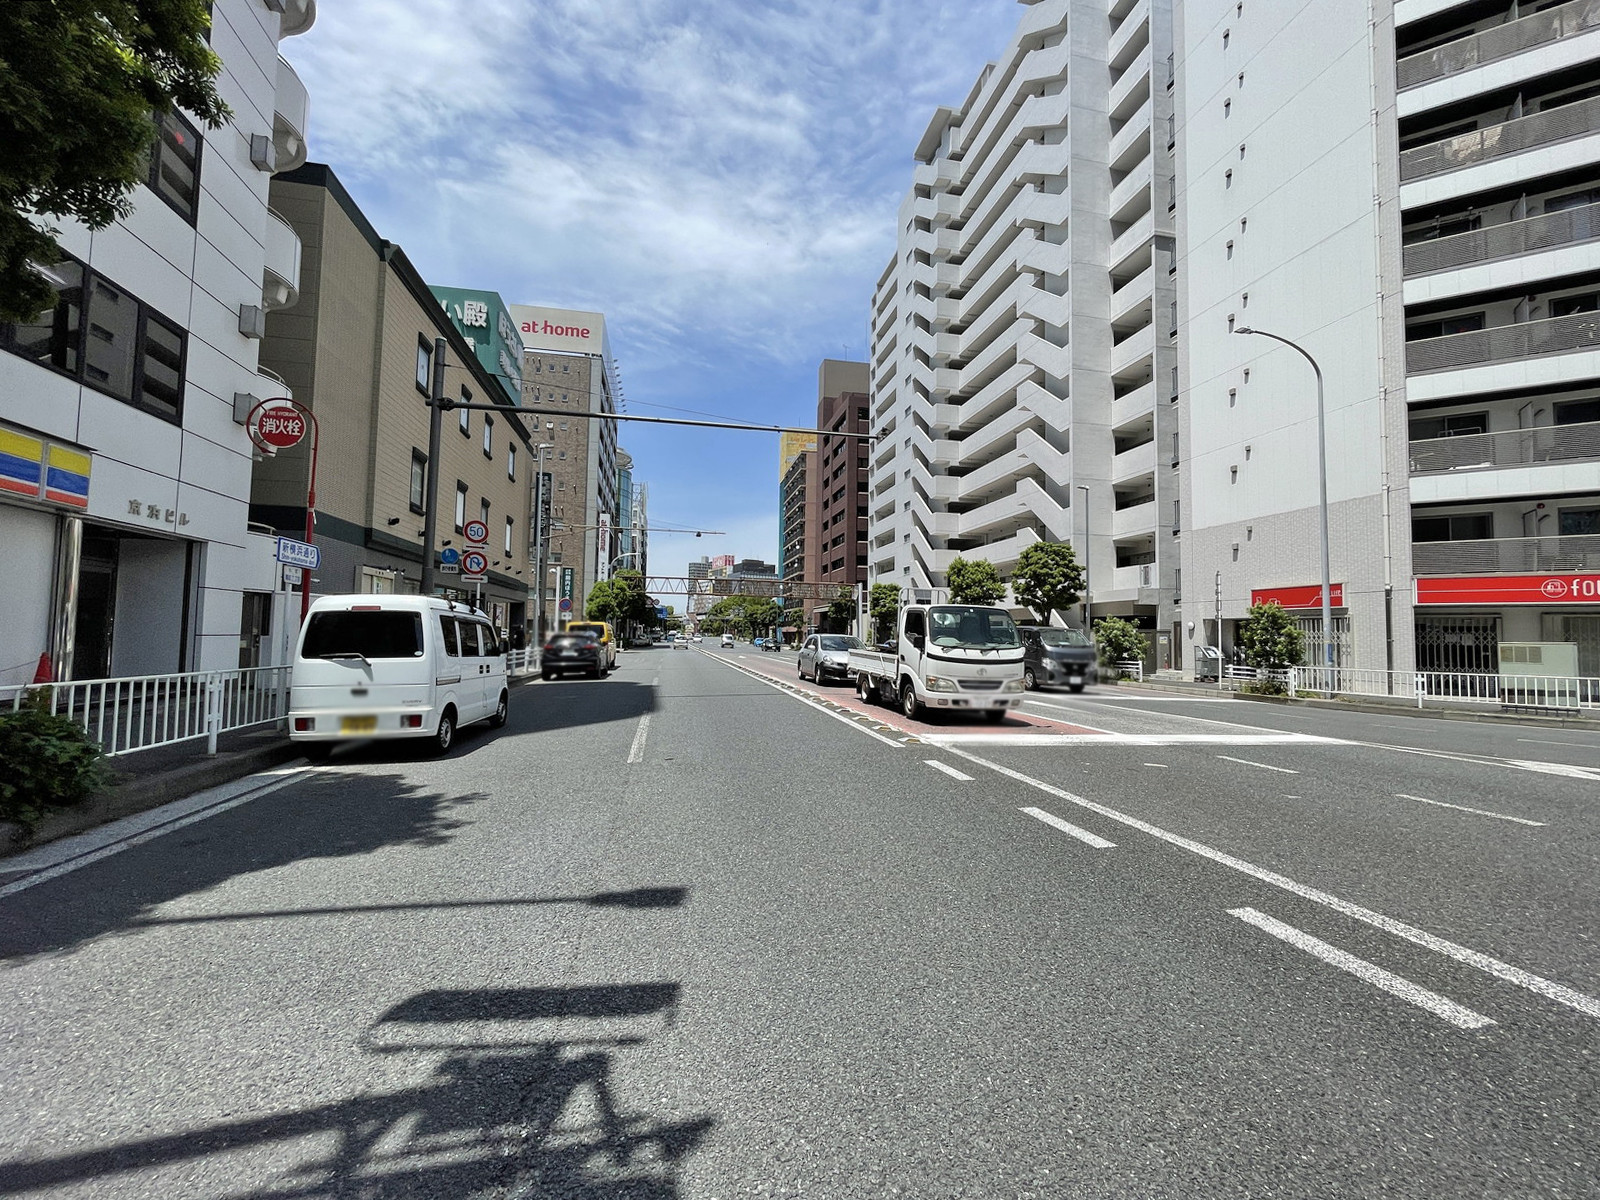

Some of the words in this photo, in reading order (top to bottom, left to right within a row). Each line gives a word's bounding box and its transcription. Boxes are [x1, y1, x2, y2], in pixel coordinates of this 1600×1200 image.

[521, 321, 539, 334] at
[540, 320, 591, 339] home
[262, 417, 302, 436] 消火栓
[469, 526, 484, 538] 50
[282, 541, 316, 559] 新横浜通り
